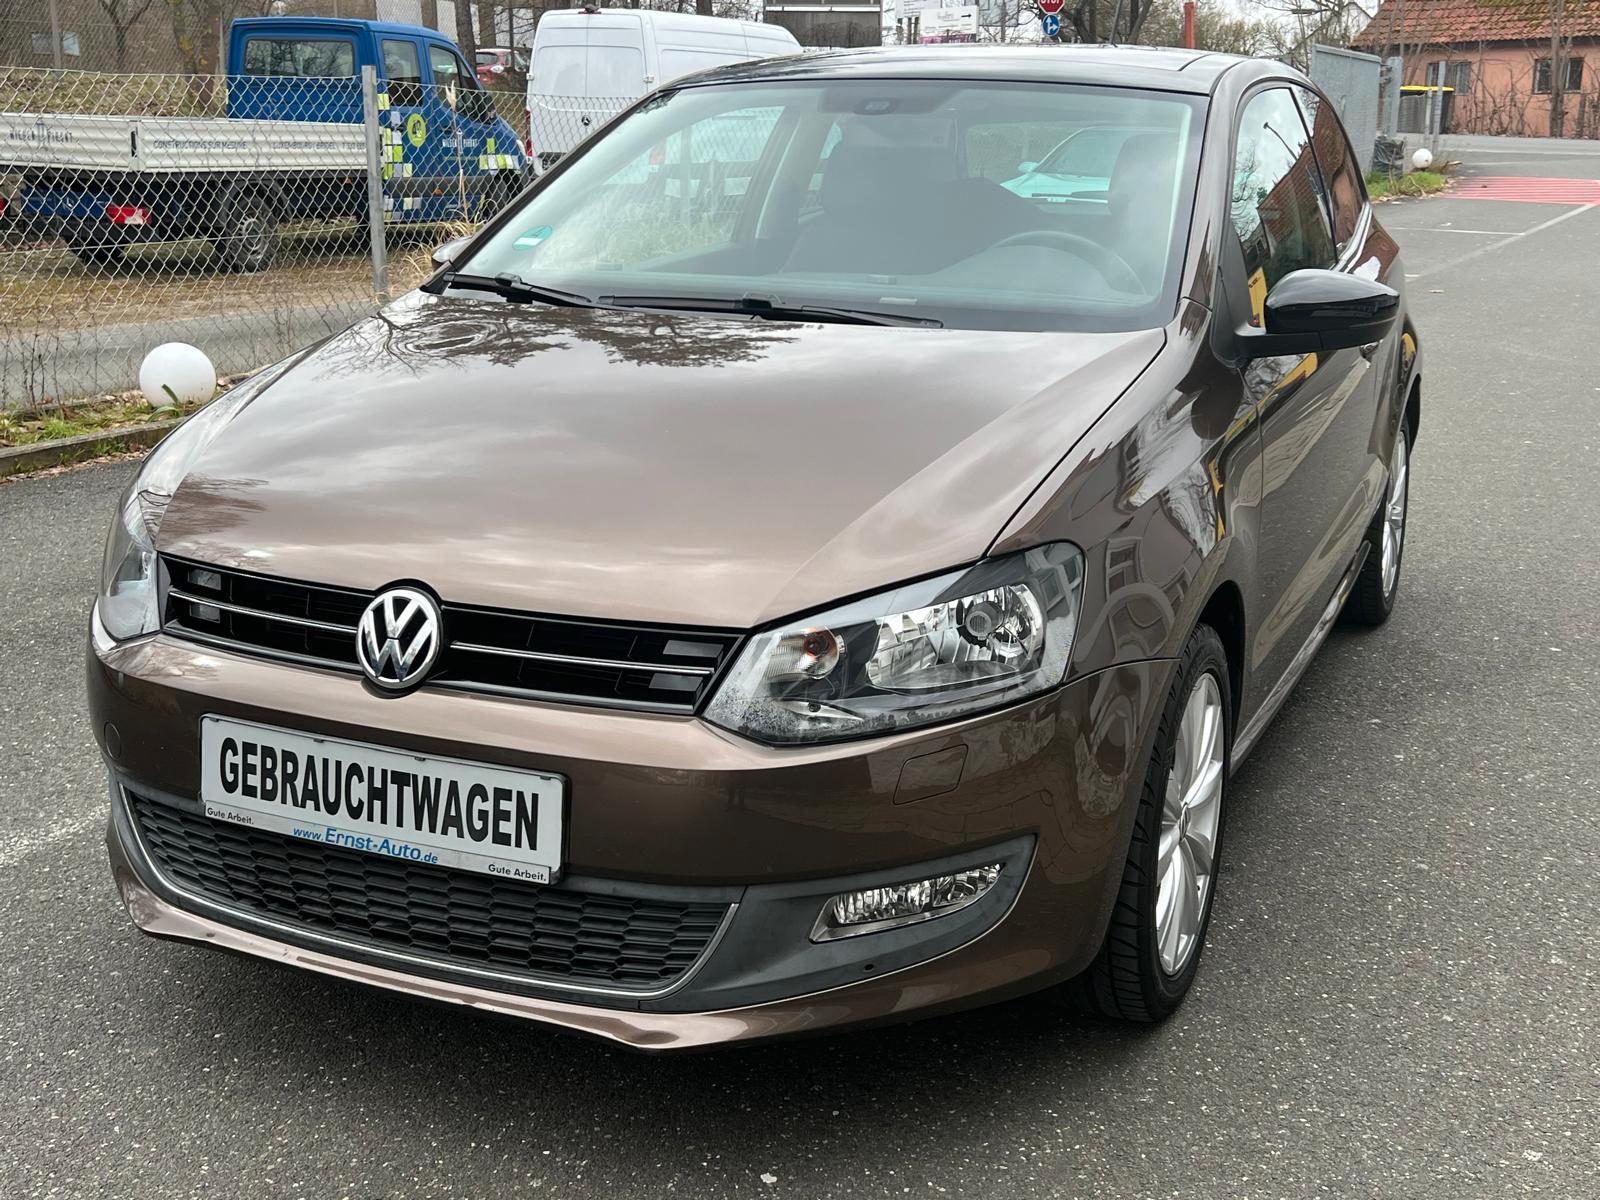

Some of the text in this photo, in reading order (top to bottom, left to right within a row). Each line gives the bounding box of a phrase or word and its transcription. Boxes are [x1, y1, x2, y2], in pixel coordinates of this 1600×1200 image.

[220, 737, 539, 851] GEBRAUCHTWAGEN
[207, 807, 254, 825] Gute Arbeit.
[293, 826, 438, 864] www.Ernst-Auto.de
[488, 863, 547, 882] Gute Arbeit.
